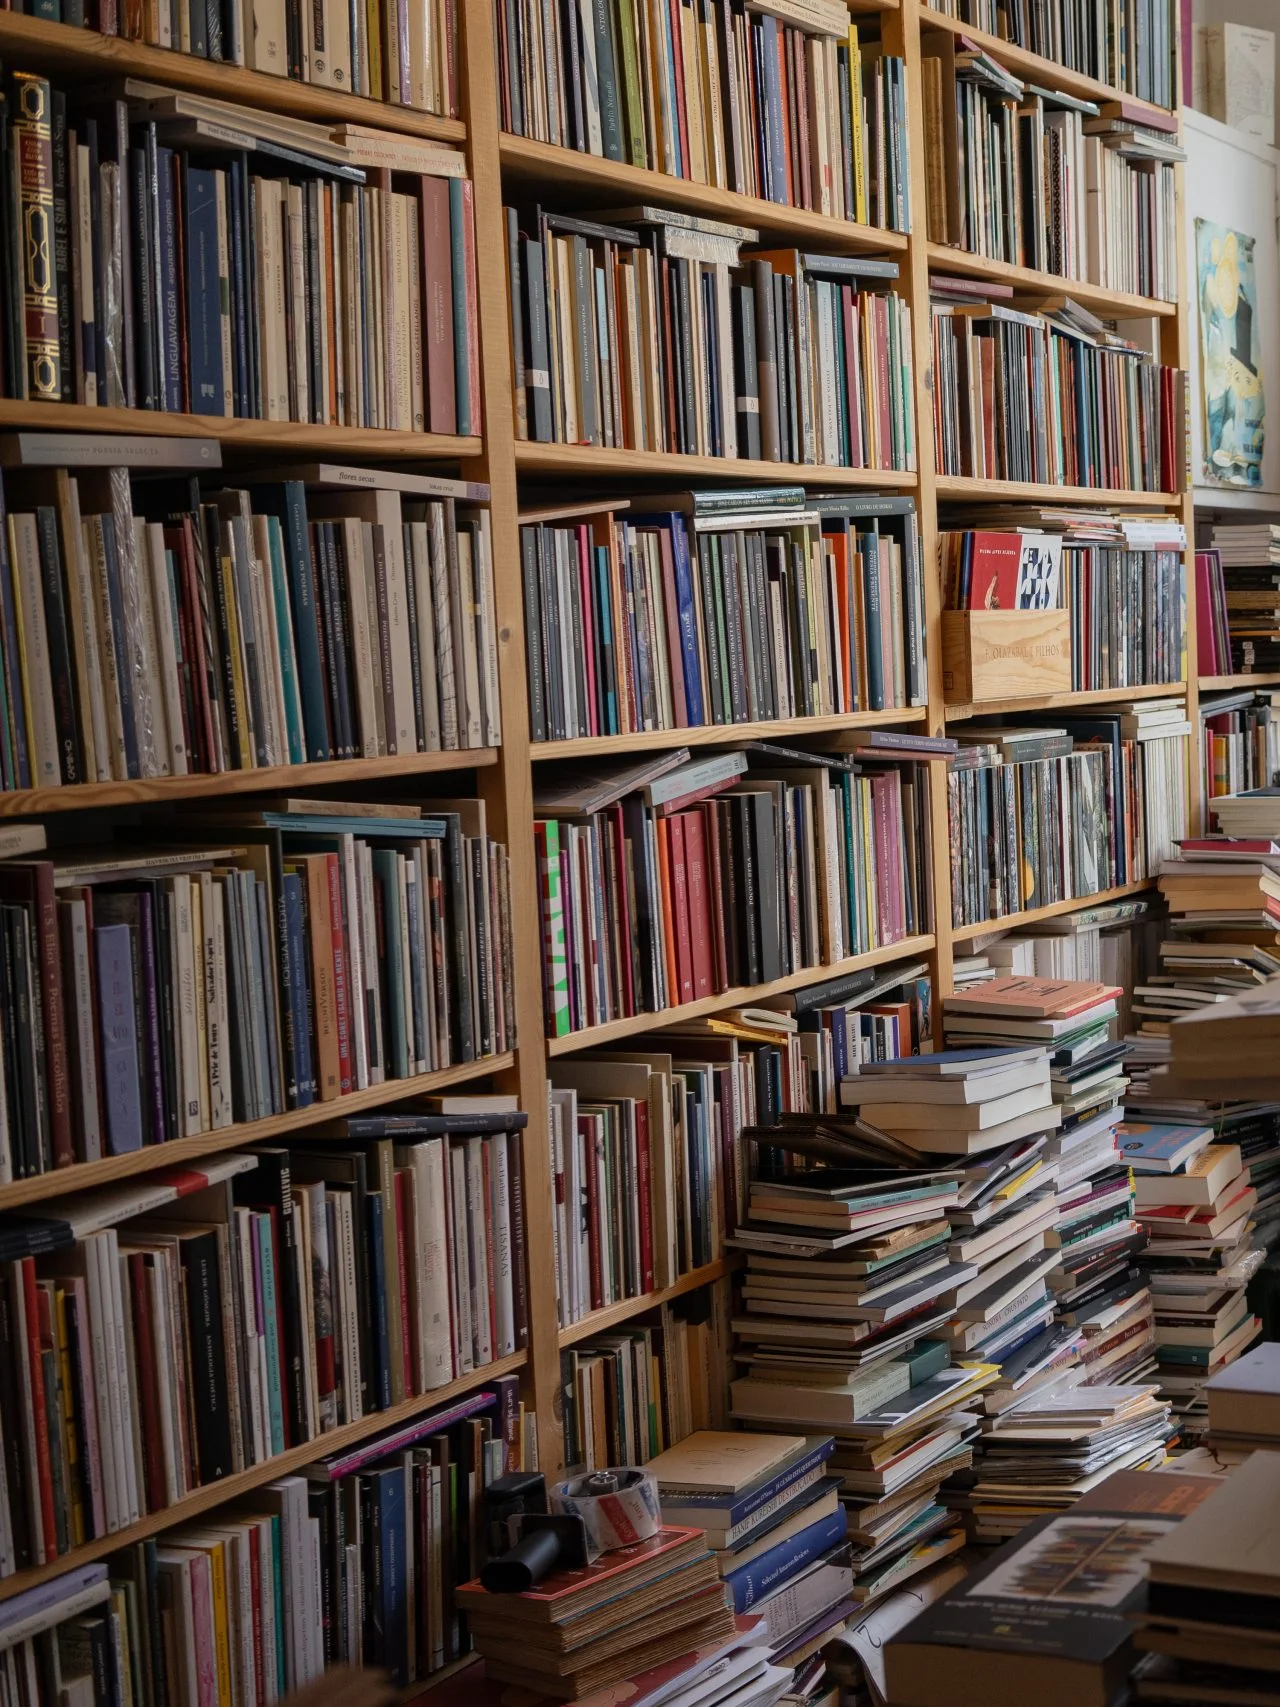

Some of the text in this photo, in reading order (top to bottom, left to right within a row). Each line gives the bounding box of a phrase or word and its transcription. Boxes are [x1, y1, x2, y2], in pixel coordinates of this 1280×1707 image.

[605, 109, 616, 133] Pablo
[163, 198, 174, 237] campos
[409, 204, 418, 255] ESCOLHIDOS
[55, 239, 69, 272] BABEL
[165, 253, 175, 284] augusto
[59, 330, 71, 343] de
[166, 290, 179, 381] LINGUAVIAGEM
[412, 351, 421, 386] ROSARIO
[581, 335, 590, 382] ESCOLHIDOS
[338, 471, 376, 484] flores secas
[299, 571, 308, 606] POEMAS
[332, 601, 342, 642] CRATERAS
[710, 648, 719, 681] POEMAS
[1036, 643, 1060, 657] FILHOS
[45, 933, 57, 965] Eliot
[279, 892, 291, 987] POESIA INÉDITA
[205, 937, 216, 1005] Salvador Espriu
[334, 949, 343, 974] MENTE
[47, 987, 65, 1114] Poemas Escolhidos
[208, 1023, 220, 1050] Touro
[279, 1168, 291, 1215] GUILLEVIC
[495, 1149, 507, 1208] Ana Hatherly
[499, 1225, 510, 1278] TISANAS
[204, 1335, 219, 1412] ANTOLOGIA POÉTICA
[731, 1473, 817, 1541] HANIF KUREISHI DESTROÇADO
[761, 1548, 811, 1587] Selected Amazon Reviews
